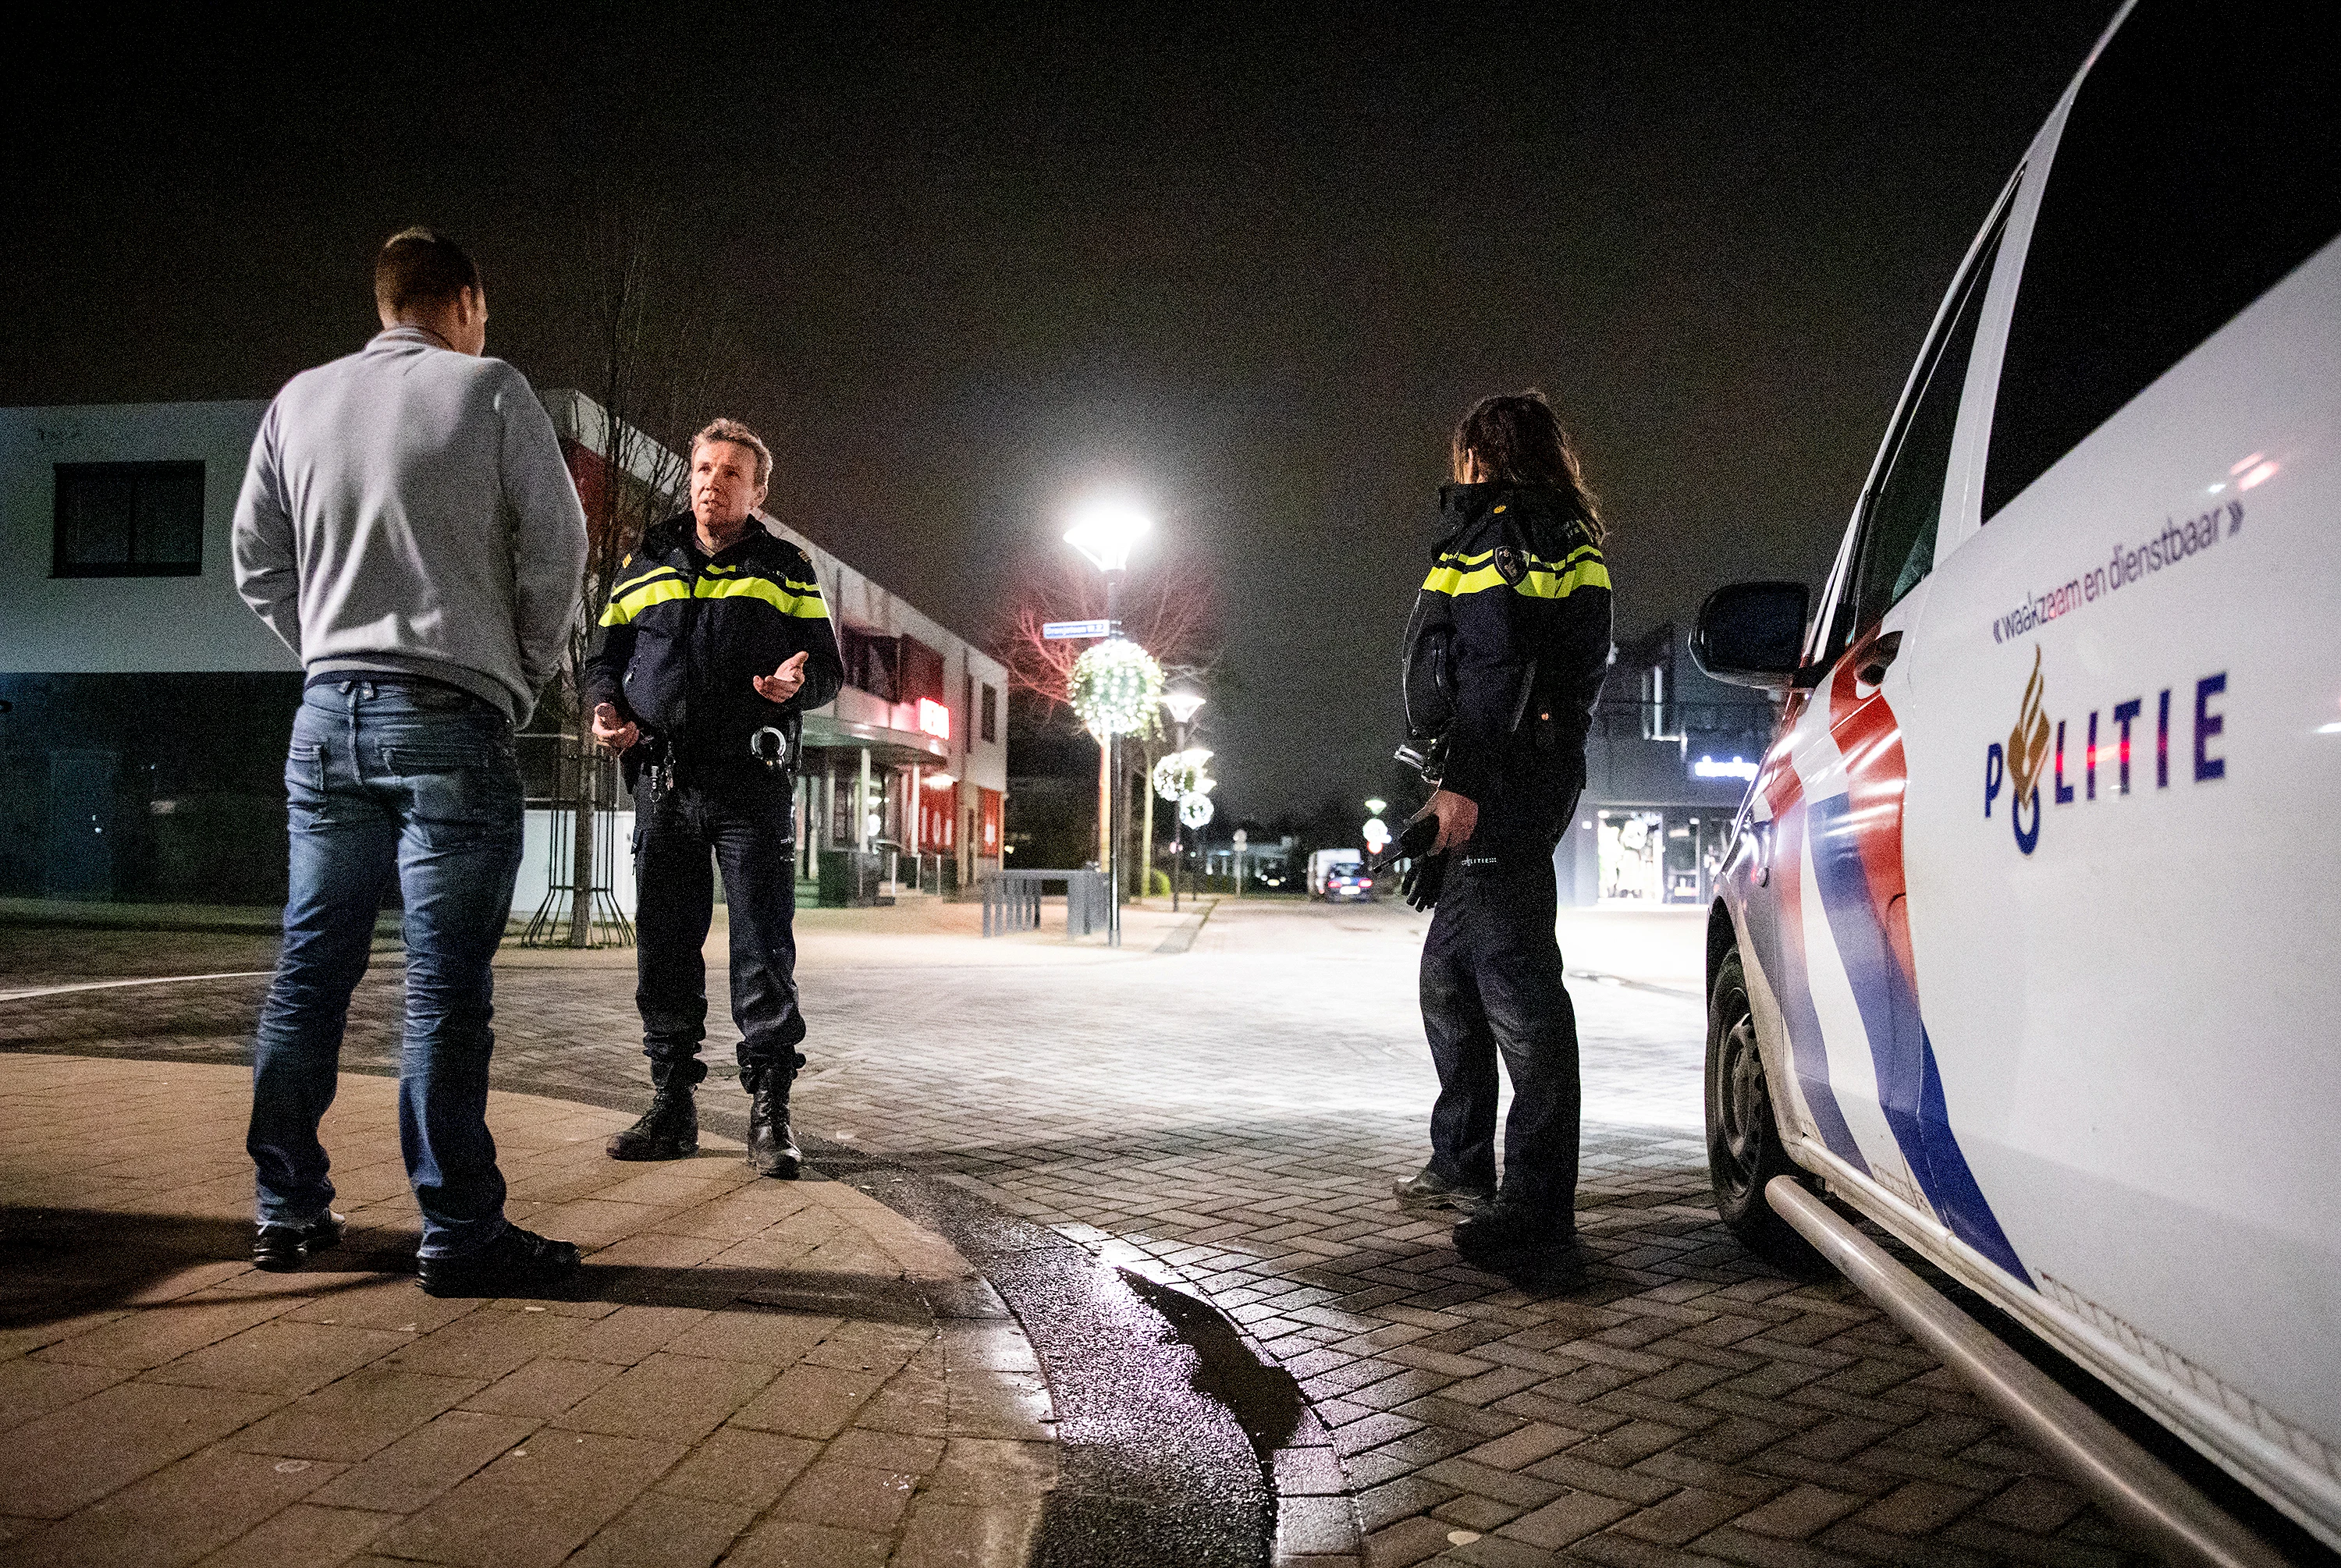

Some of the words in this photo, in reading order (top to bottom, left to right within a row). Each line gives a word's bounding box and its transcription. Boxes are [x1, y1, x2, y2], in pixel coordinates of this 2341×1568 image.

[2084, 567, 2107, 602] en
[2108, 507, 2222, 591] dienstbaar
[1984, 671, 2228, 857] POLITIE
